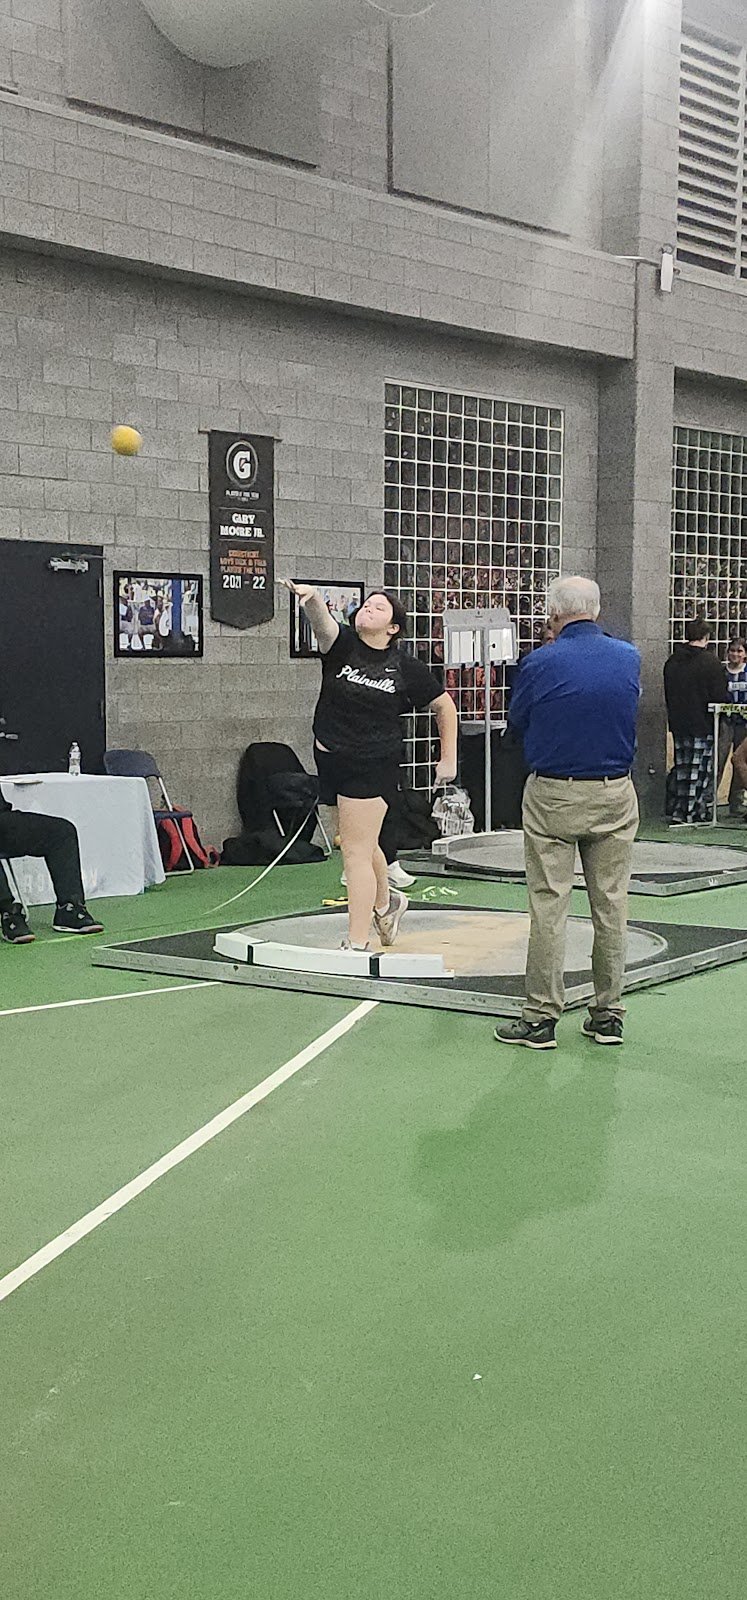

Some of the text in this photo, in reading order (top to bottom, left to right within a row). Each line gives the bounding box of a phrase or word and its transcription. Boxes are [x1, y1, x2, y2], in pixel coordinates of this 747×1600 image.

[233, 451, 251, 479] G
[232, 513, 255, 524] GARY
[220, 525, 252, 537] MOORE
[222, 574, 242, 589] 2021
[252, 576, 266, 590] 22
[336, 664, 396, 694] Plainville
